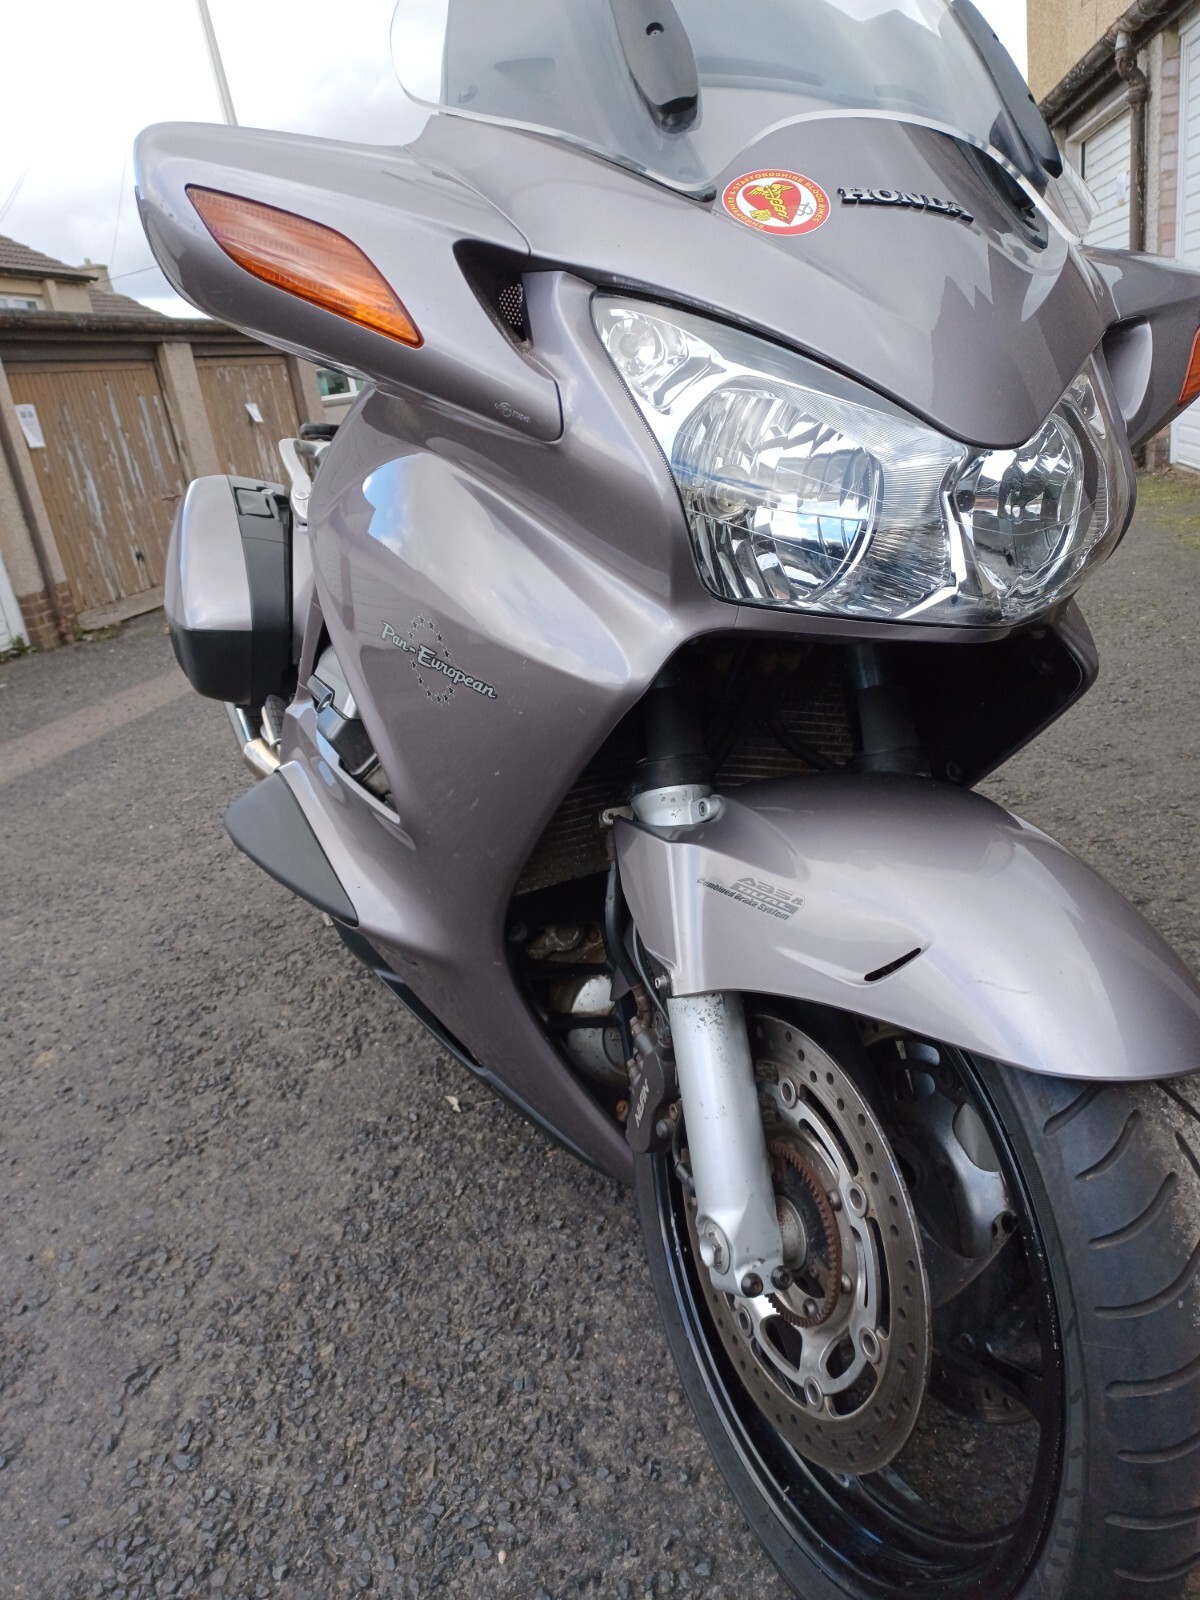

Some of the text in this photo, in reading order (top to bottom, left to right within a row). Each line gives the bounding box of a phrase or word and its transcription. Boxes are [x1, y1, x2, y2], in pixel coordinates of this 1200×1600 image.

[735, 172, 804, 191] STAFFORDSHIRE
[805, 182, 824, 203] BLOOD
[813, 204, 826, 223] BIKES
[837, 187, 974, 222] HONDA
[696, 877, 790, 921] Combined Brake System
